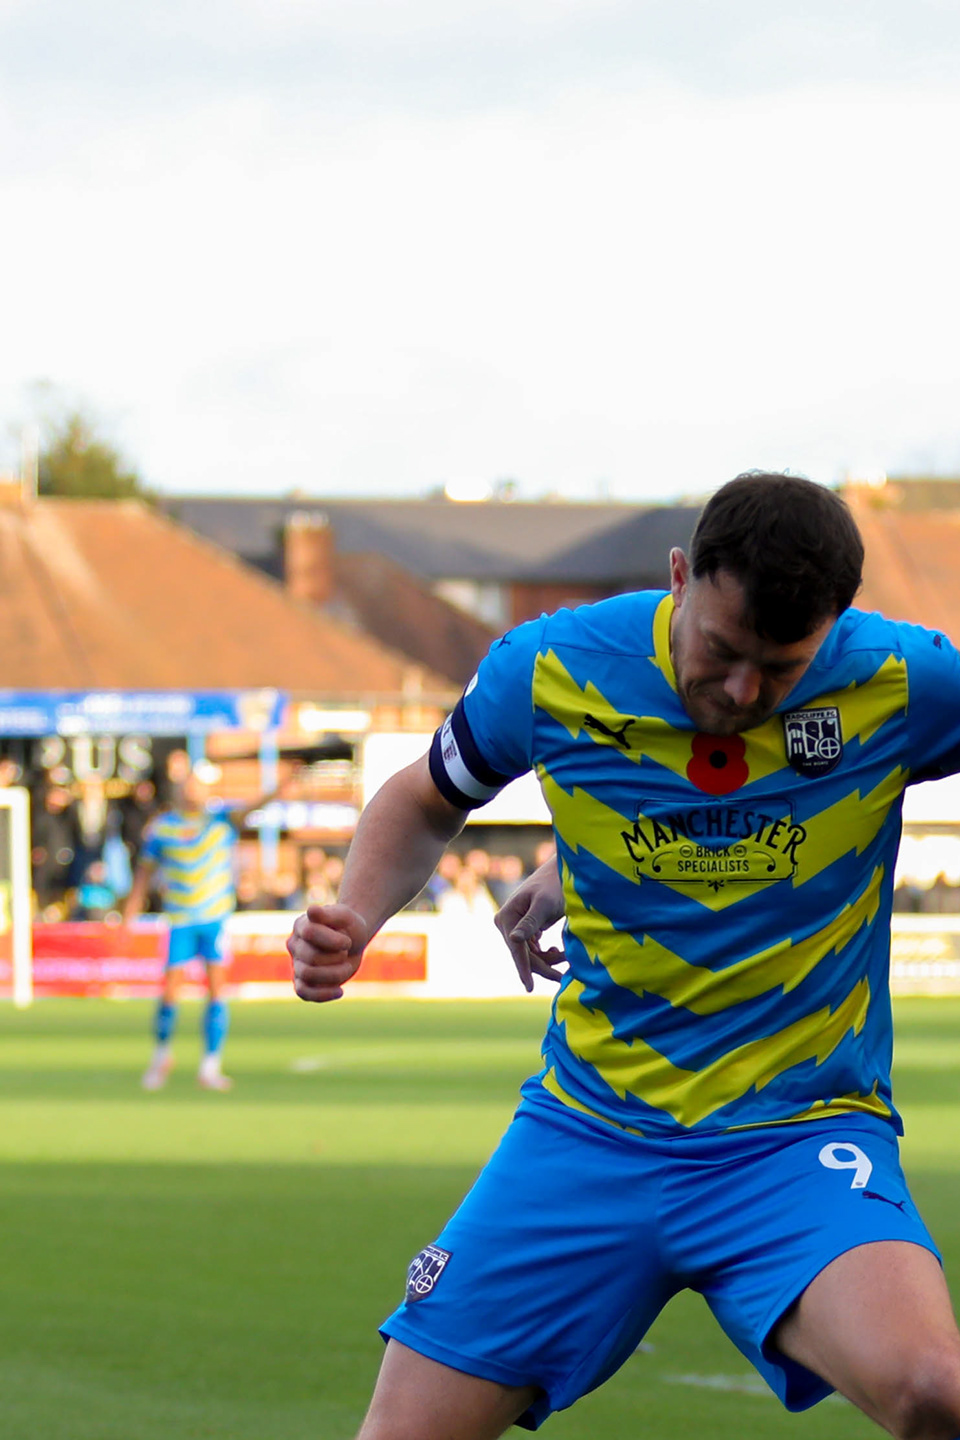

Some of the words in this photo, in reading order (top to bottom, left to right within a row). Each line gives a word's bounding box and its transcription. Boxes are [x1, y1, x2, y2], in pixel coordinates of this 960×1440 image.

[620, 808, 807, 865] MANCHESTER
[696, 845, 731, 858] BRICK
[677, 860, 750, 873] SPECIALISTS
[818, 1142, 873, 1190] 9
